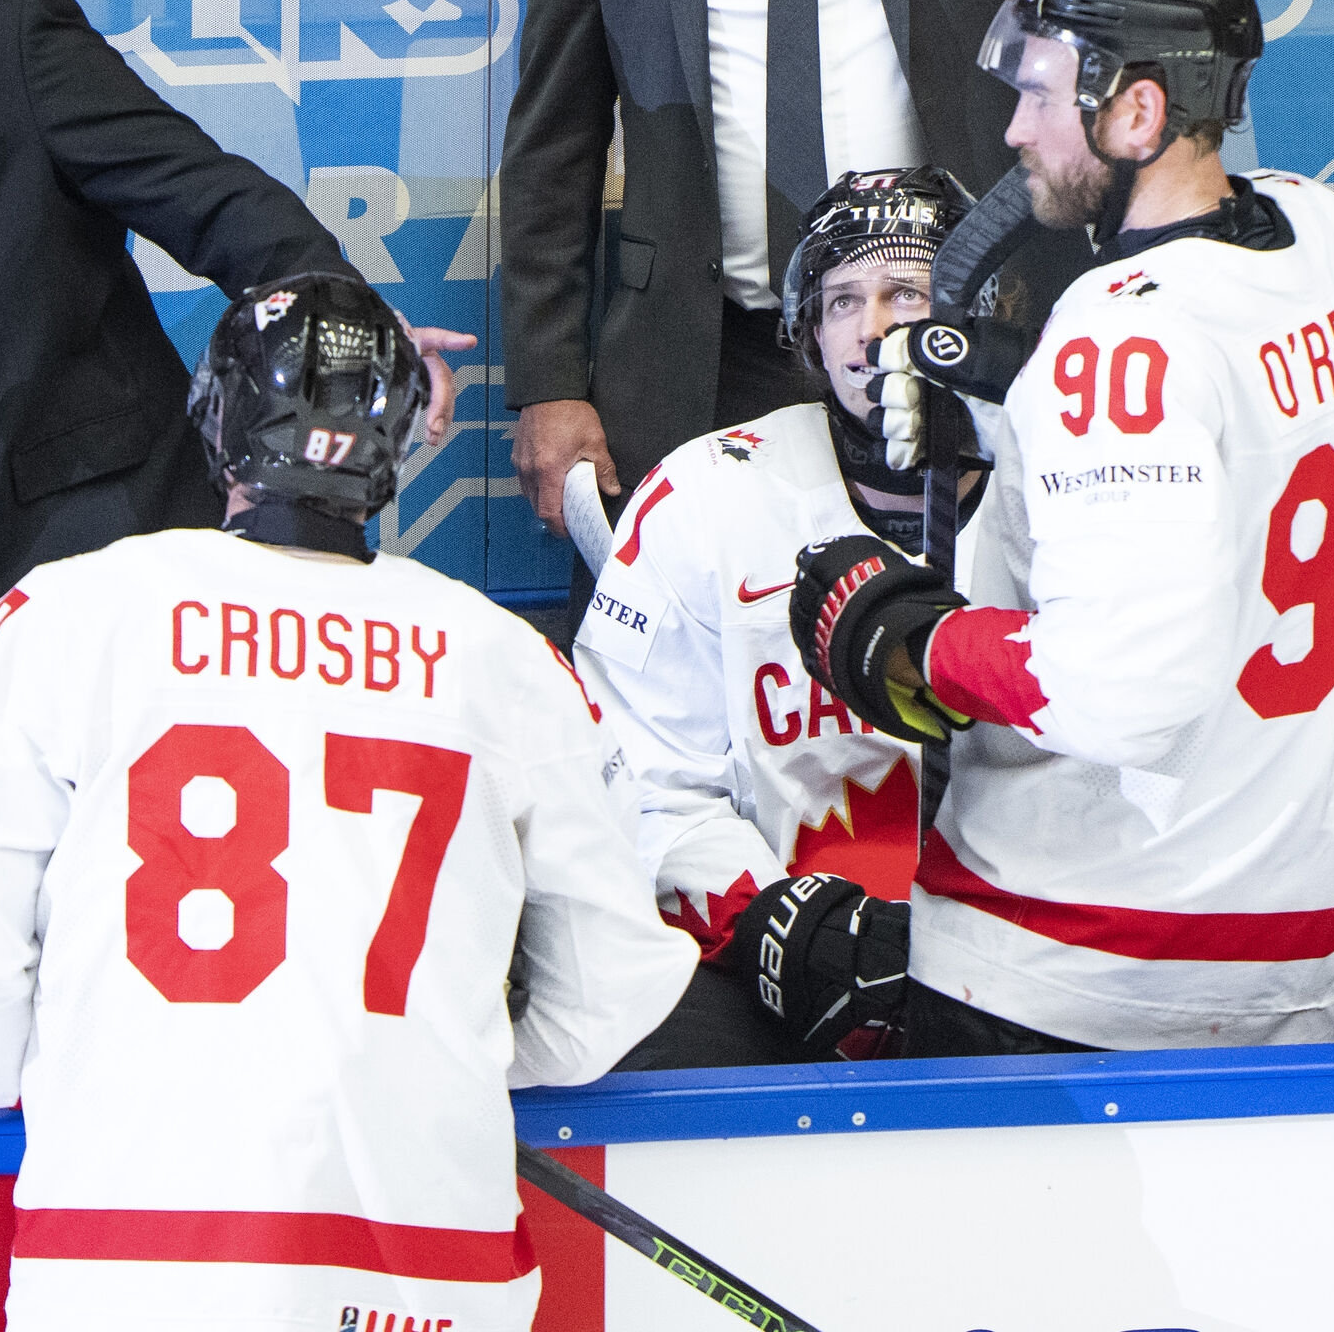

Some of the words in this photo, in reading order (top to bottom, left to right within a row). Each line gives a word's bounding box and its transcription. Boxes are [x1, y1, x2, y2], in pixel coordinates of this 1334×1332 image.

[850, 205, 934, 224] TELUS
[1054, 335, 1170, 438] 90
[303, 427, 357, 466] 87
[1040, 464, 1204, 497] WESTMINSTER
[171, 598, 448, 699] CROSBY
[754, 661, 875, 746] CA
[126, 724, 472, 1017] 87
